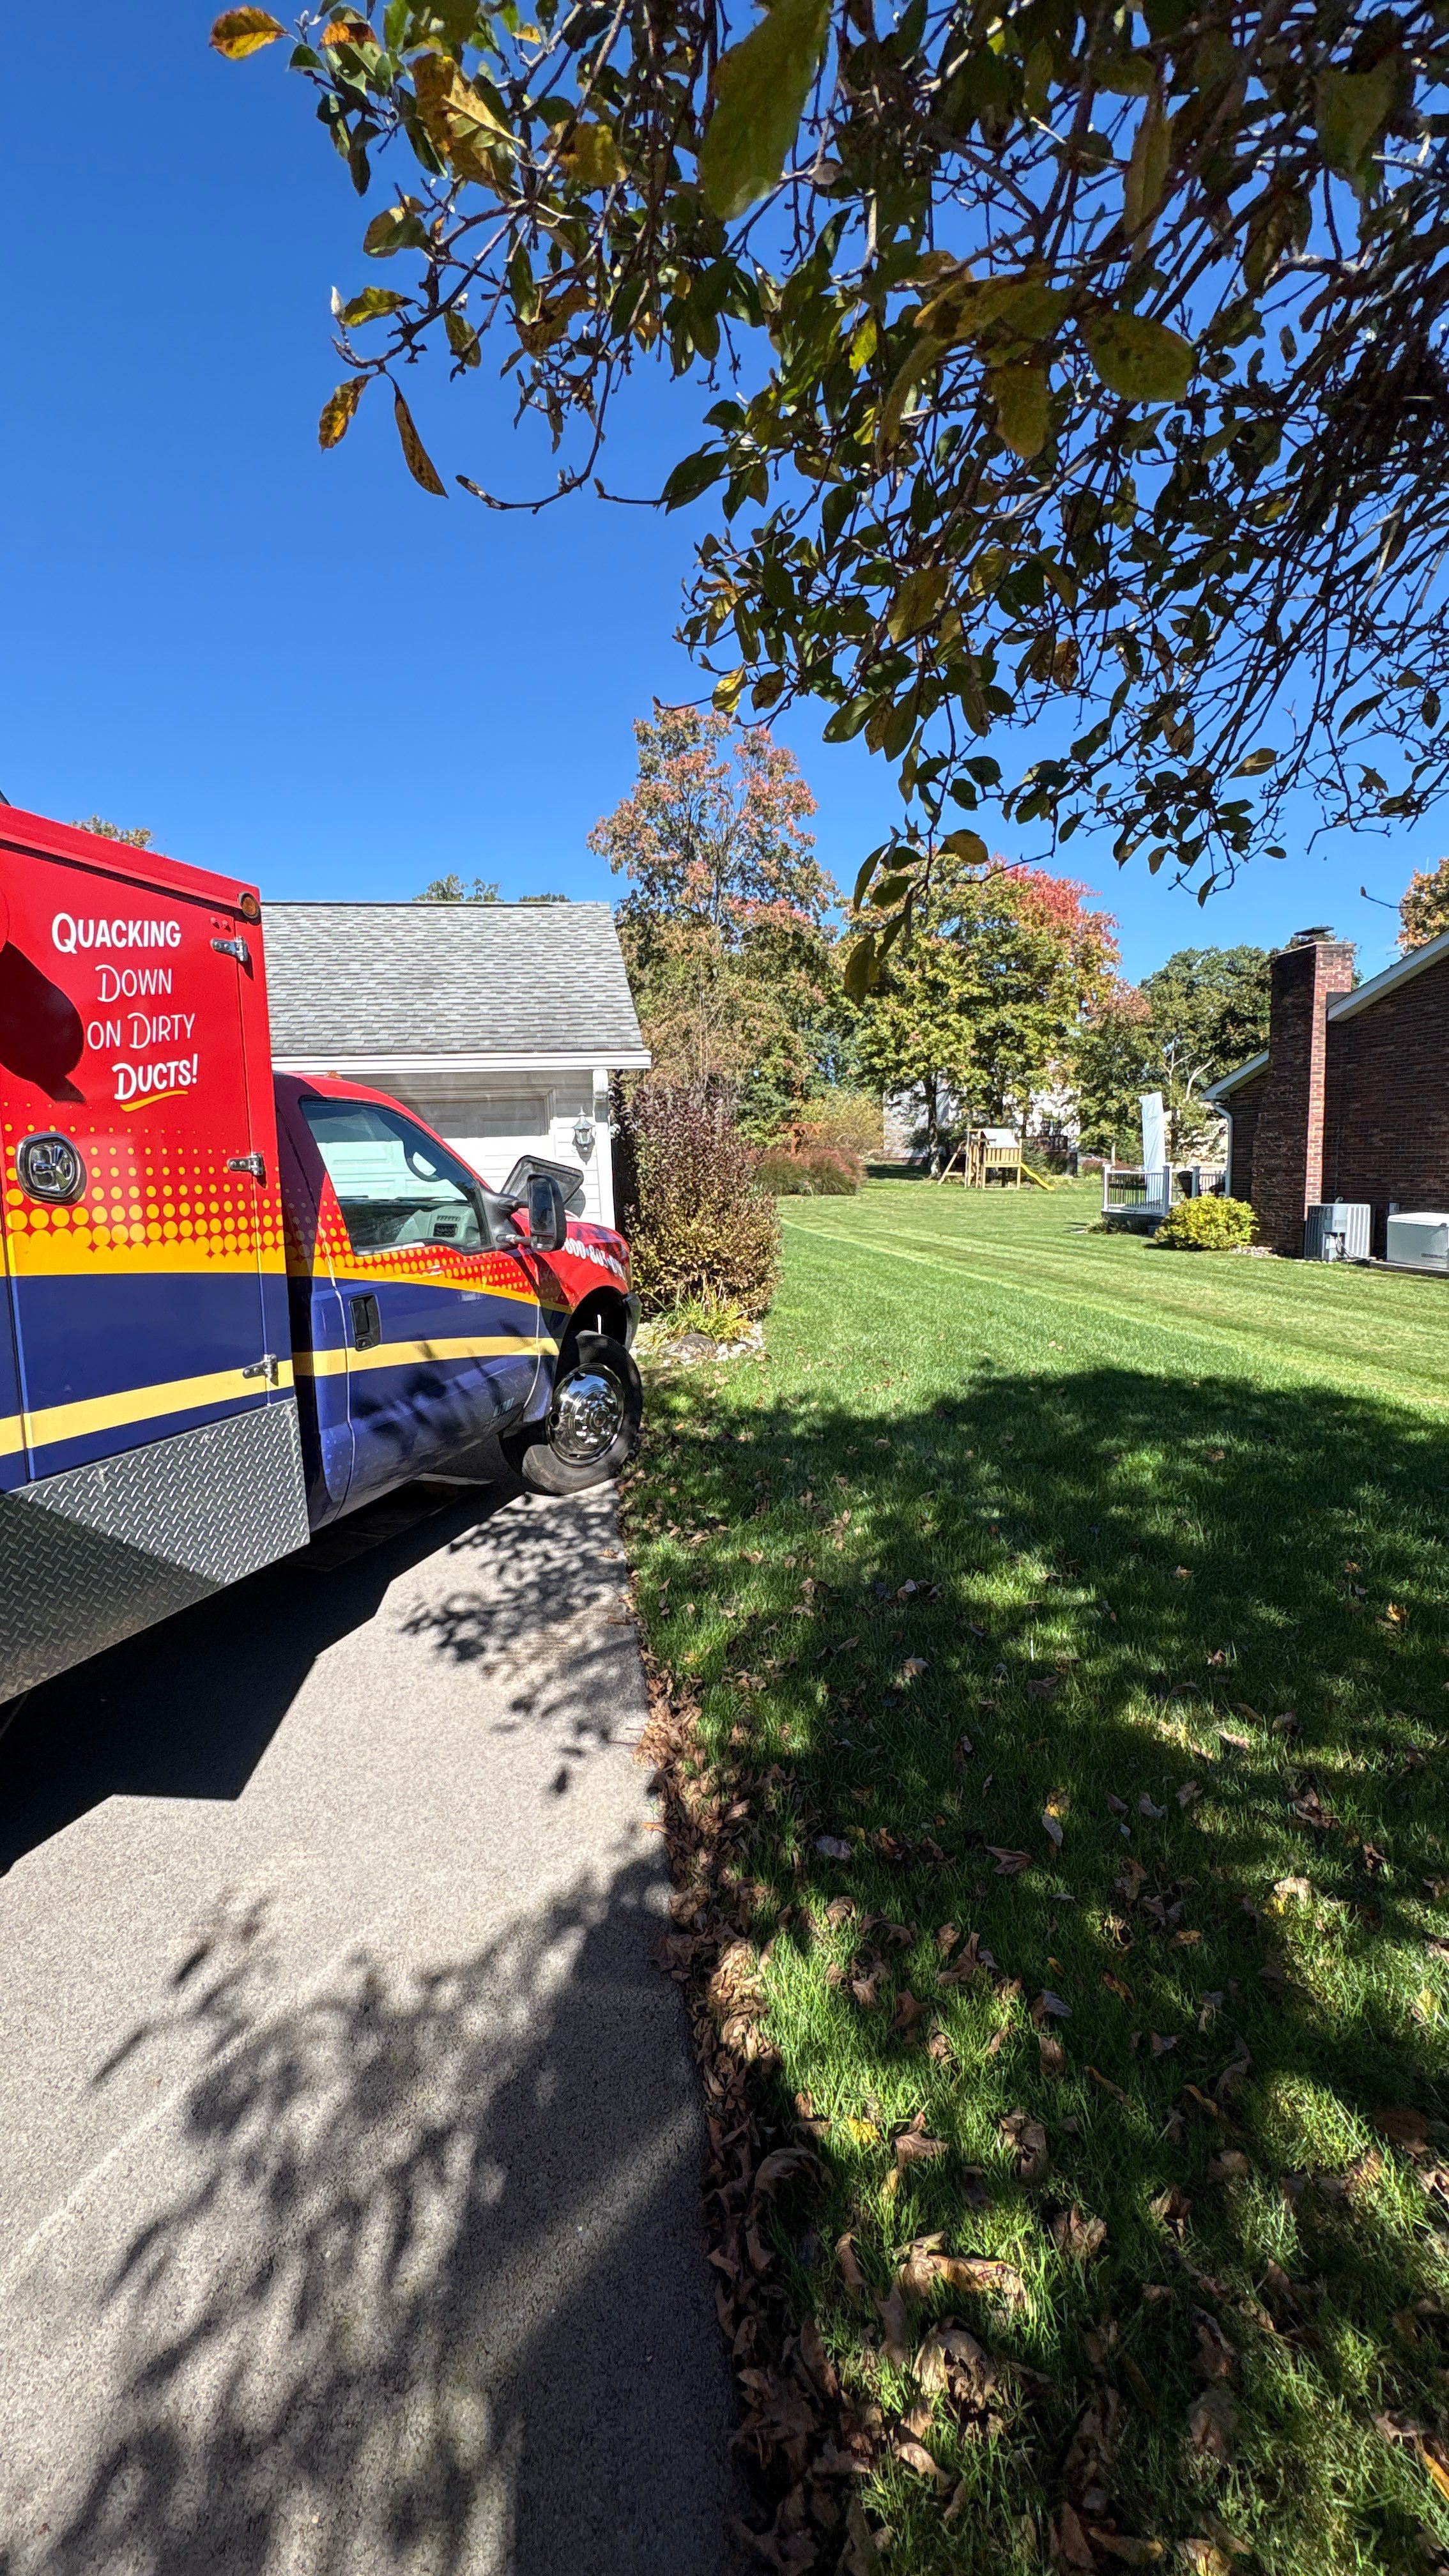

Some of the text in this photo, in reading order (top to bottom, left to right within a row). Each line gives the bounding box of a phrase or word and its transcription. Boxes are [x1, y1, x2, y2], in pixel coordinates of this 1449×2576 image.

[52, 912, 181, 954] QUACKING
[95, 965, 171, 1002] DOWN
[87, 1012, 195, 1050] ON DIRTY
[111, 1053, 198, 1100] DUCTS!
